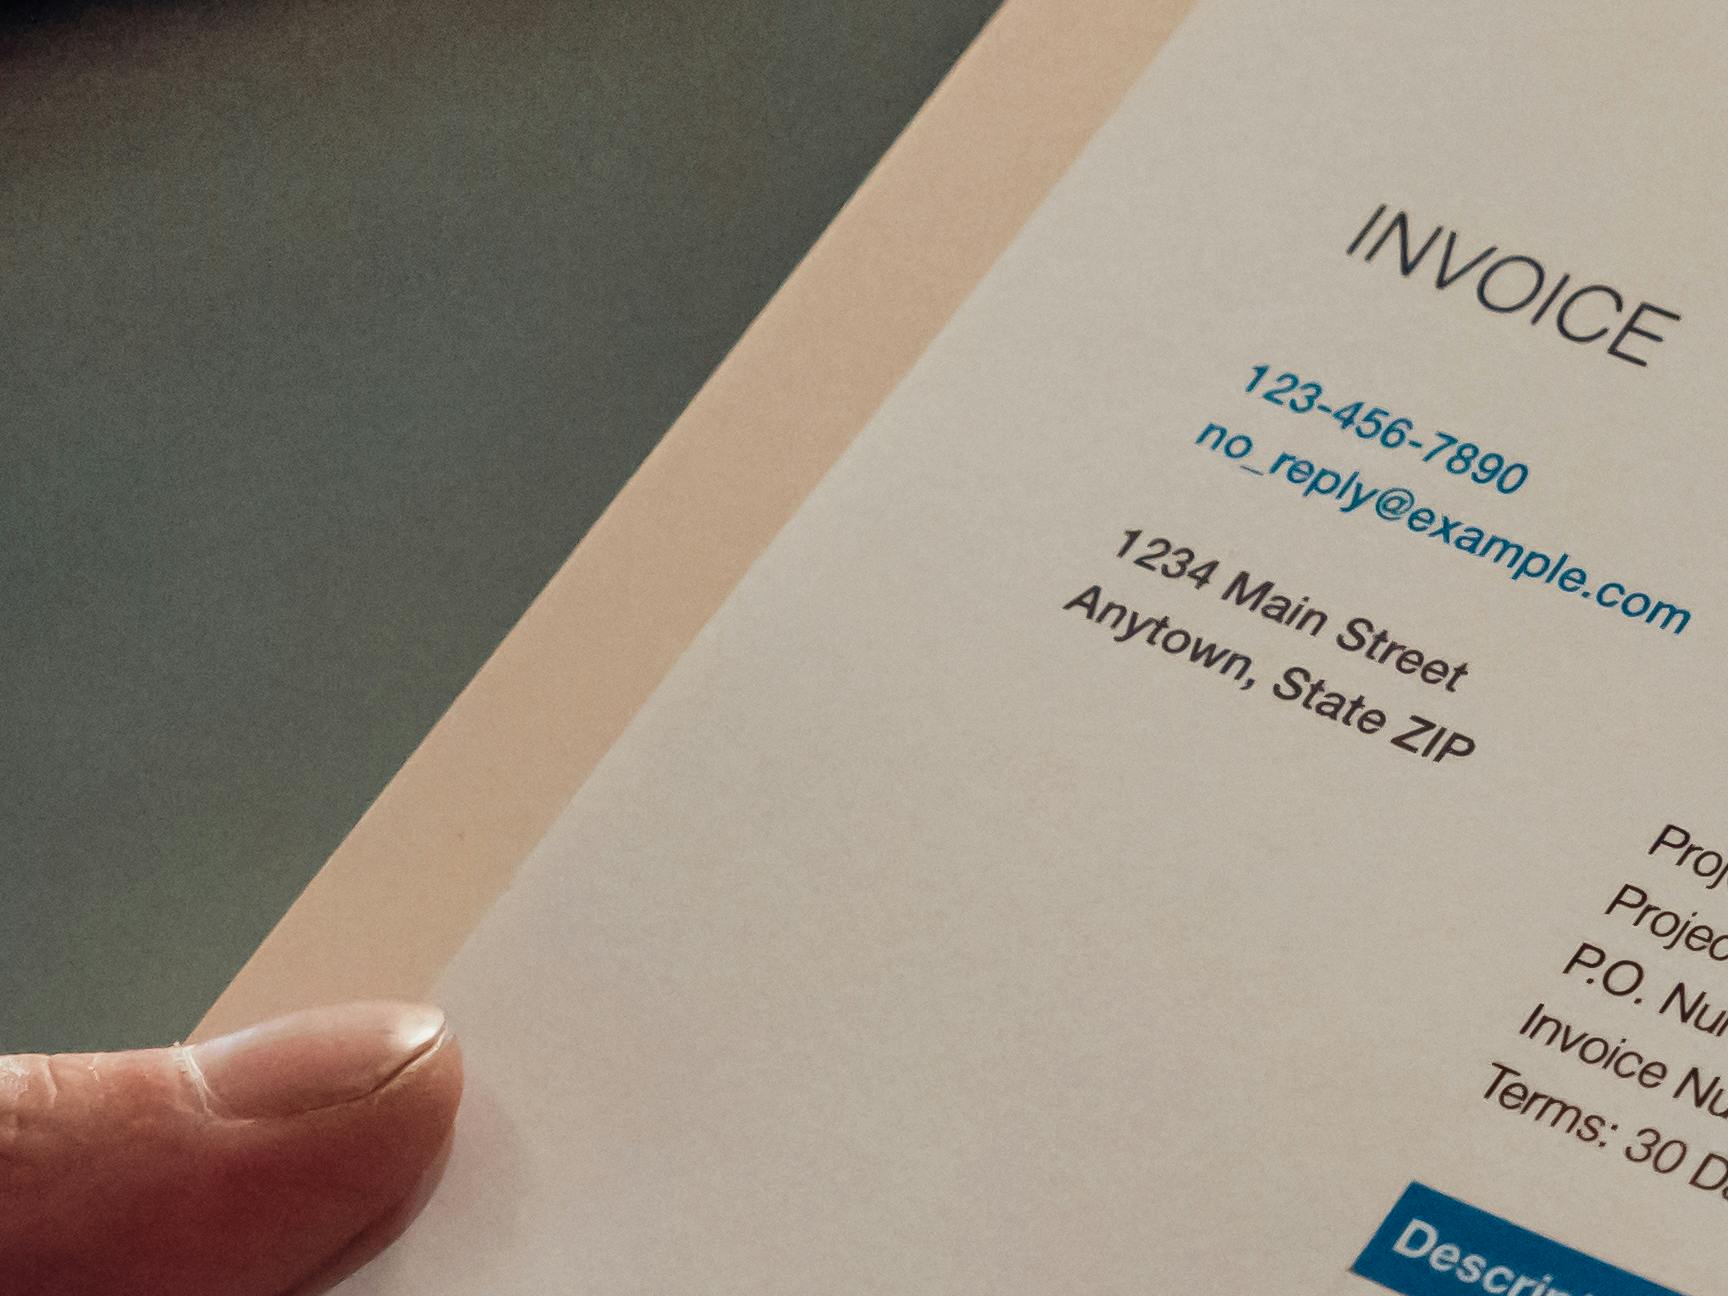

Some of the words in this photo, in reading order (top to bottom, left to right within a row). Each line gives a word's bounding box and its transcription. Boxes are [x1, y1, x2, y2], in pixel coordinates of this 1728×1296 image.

[1346, 204, 1681, 366] INVOICE
[1242, 363, 1529, 495] 123-456-7890
[1195, 421, 1692, 635] no_reply@example.com
[1064, 584, 1257, 691] Anytown,
[1272, 666, 1387, 735] State
[1391, 715, 1476, 765] ZIP
[1116, 528, 1221, 589] 1234
[1222, 571, 1329, 636] Main
[1336, 616, 1470, 693] Street
[1519, 1003, 1668, 1089] Invoice
[1562, 942, 1644, 1003] P.O.
[1481, 1062, 1619, 1148] Terms:
[1624, 1127, 1686, 1175] 30
